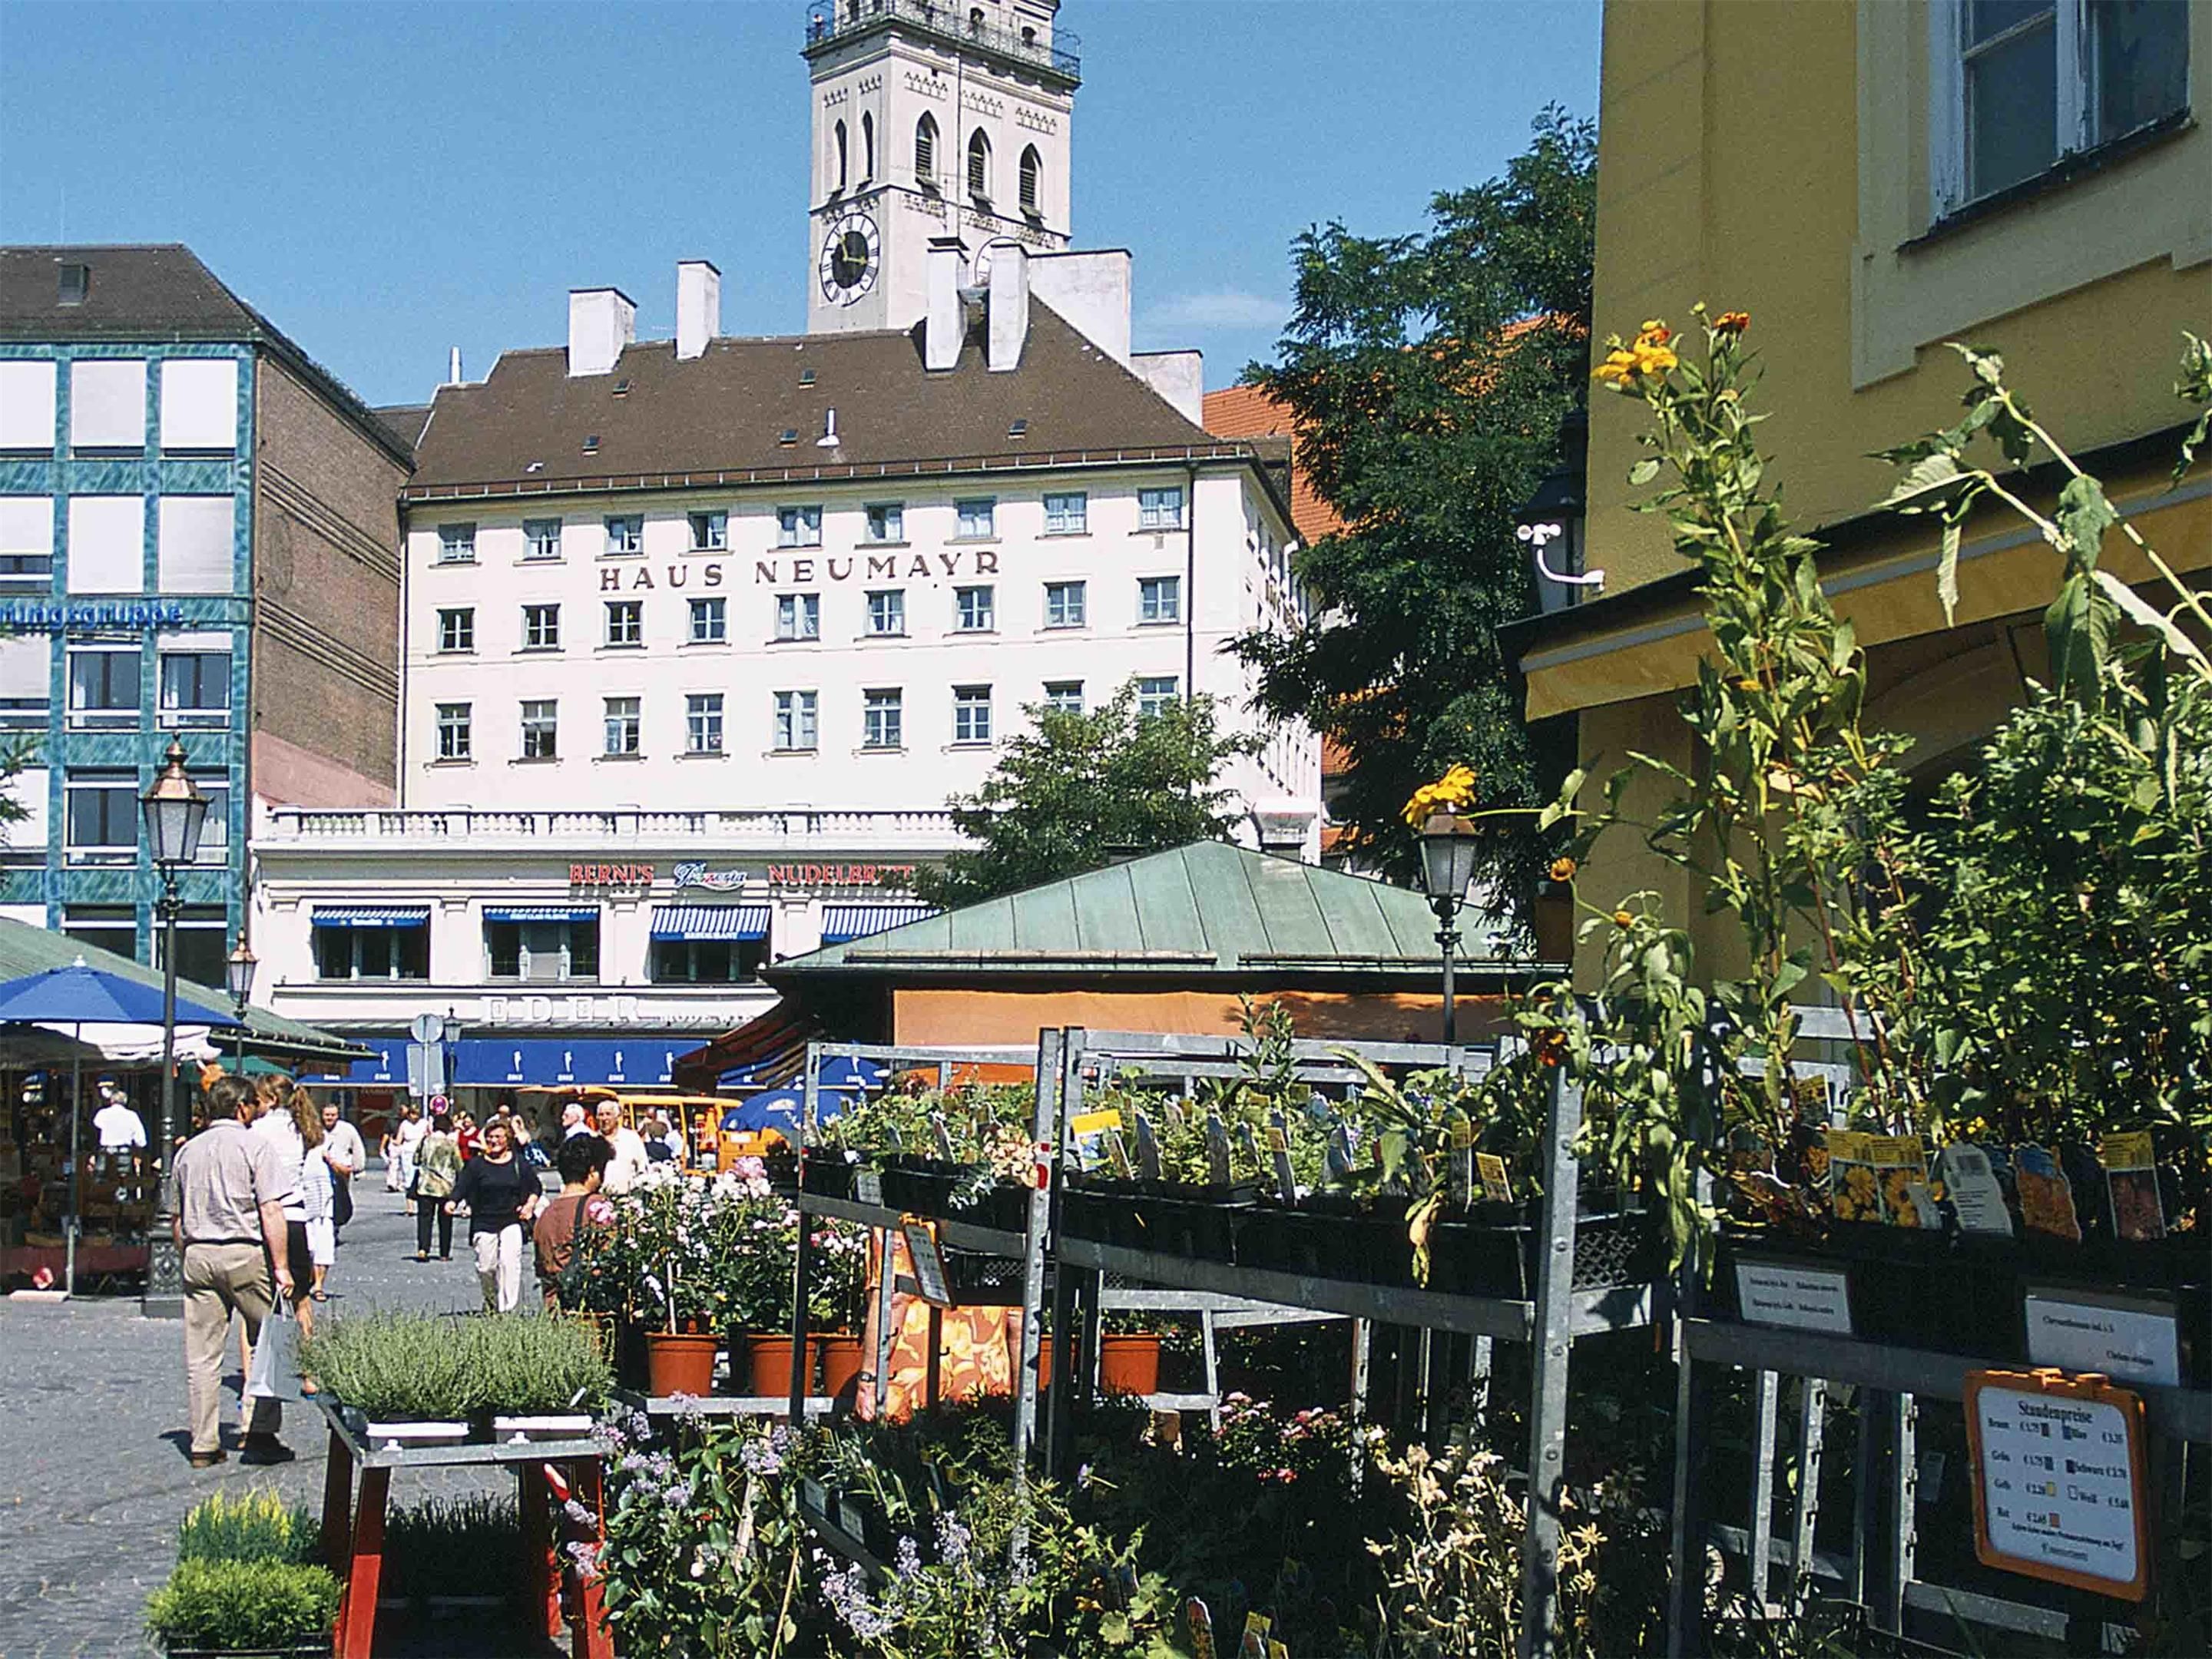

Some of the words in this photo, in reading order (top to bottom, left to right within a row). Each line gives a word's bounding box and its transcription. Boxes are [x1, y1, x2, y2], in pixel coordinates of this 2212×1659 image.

[600, 563, 723, 591] HAUS
[755, 551, 999, 584] NEUMAYR
[569, 864, 654, 883] BERNI'S
[768, 864, 916, 884] NUDELBRT
[480, 995, 640, 1022] EDER
